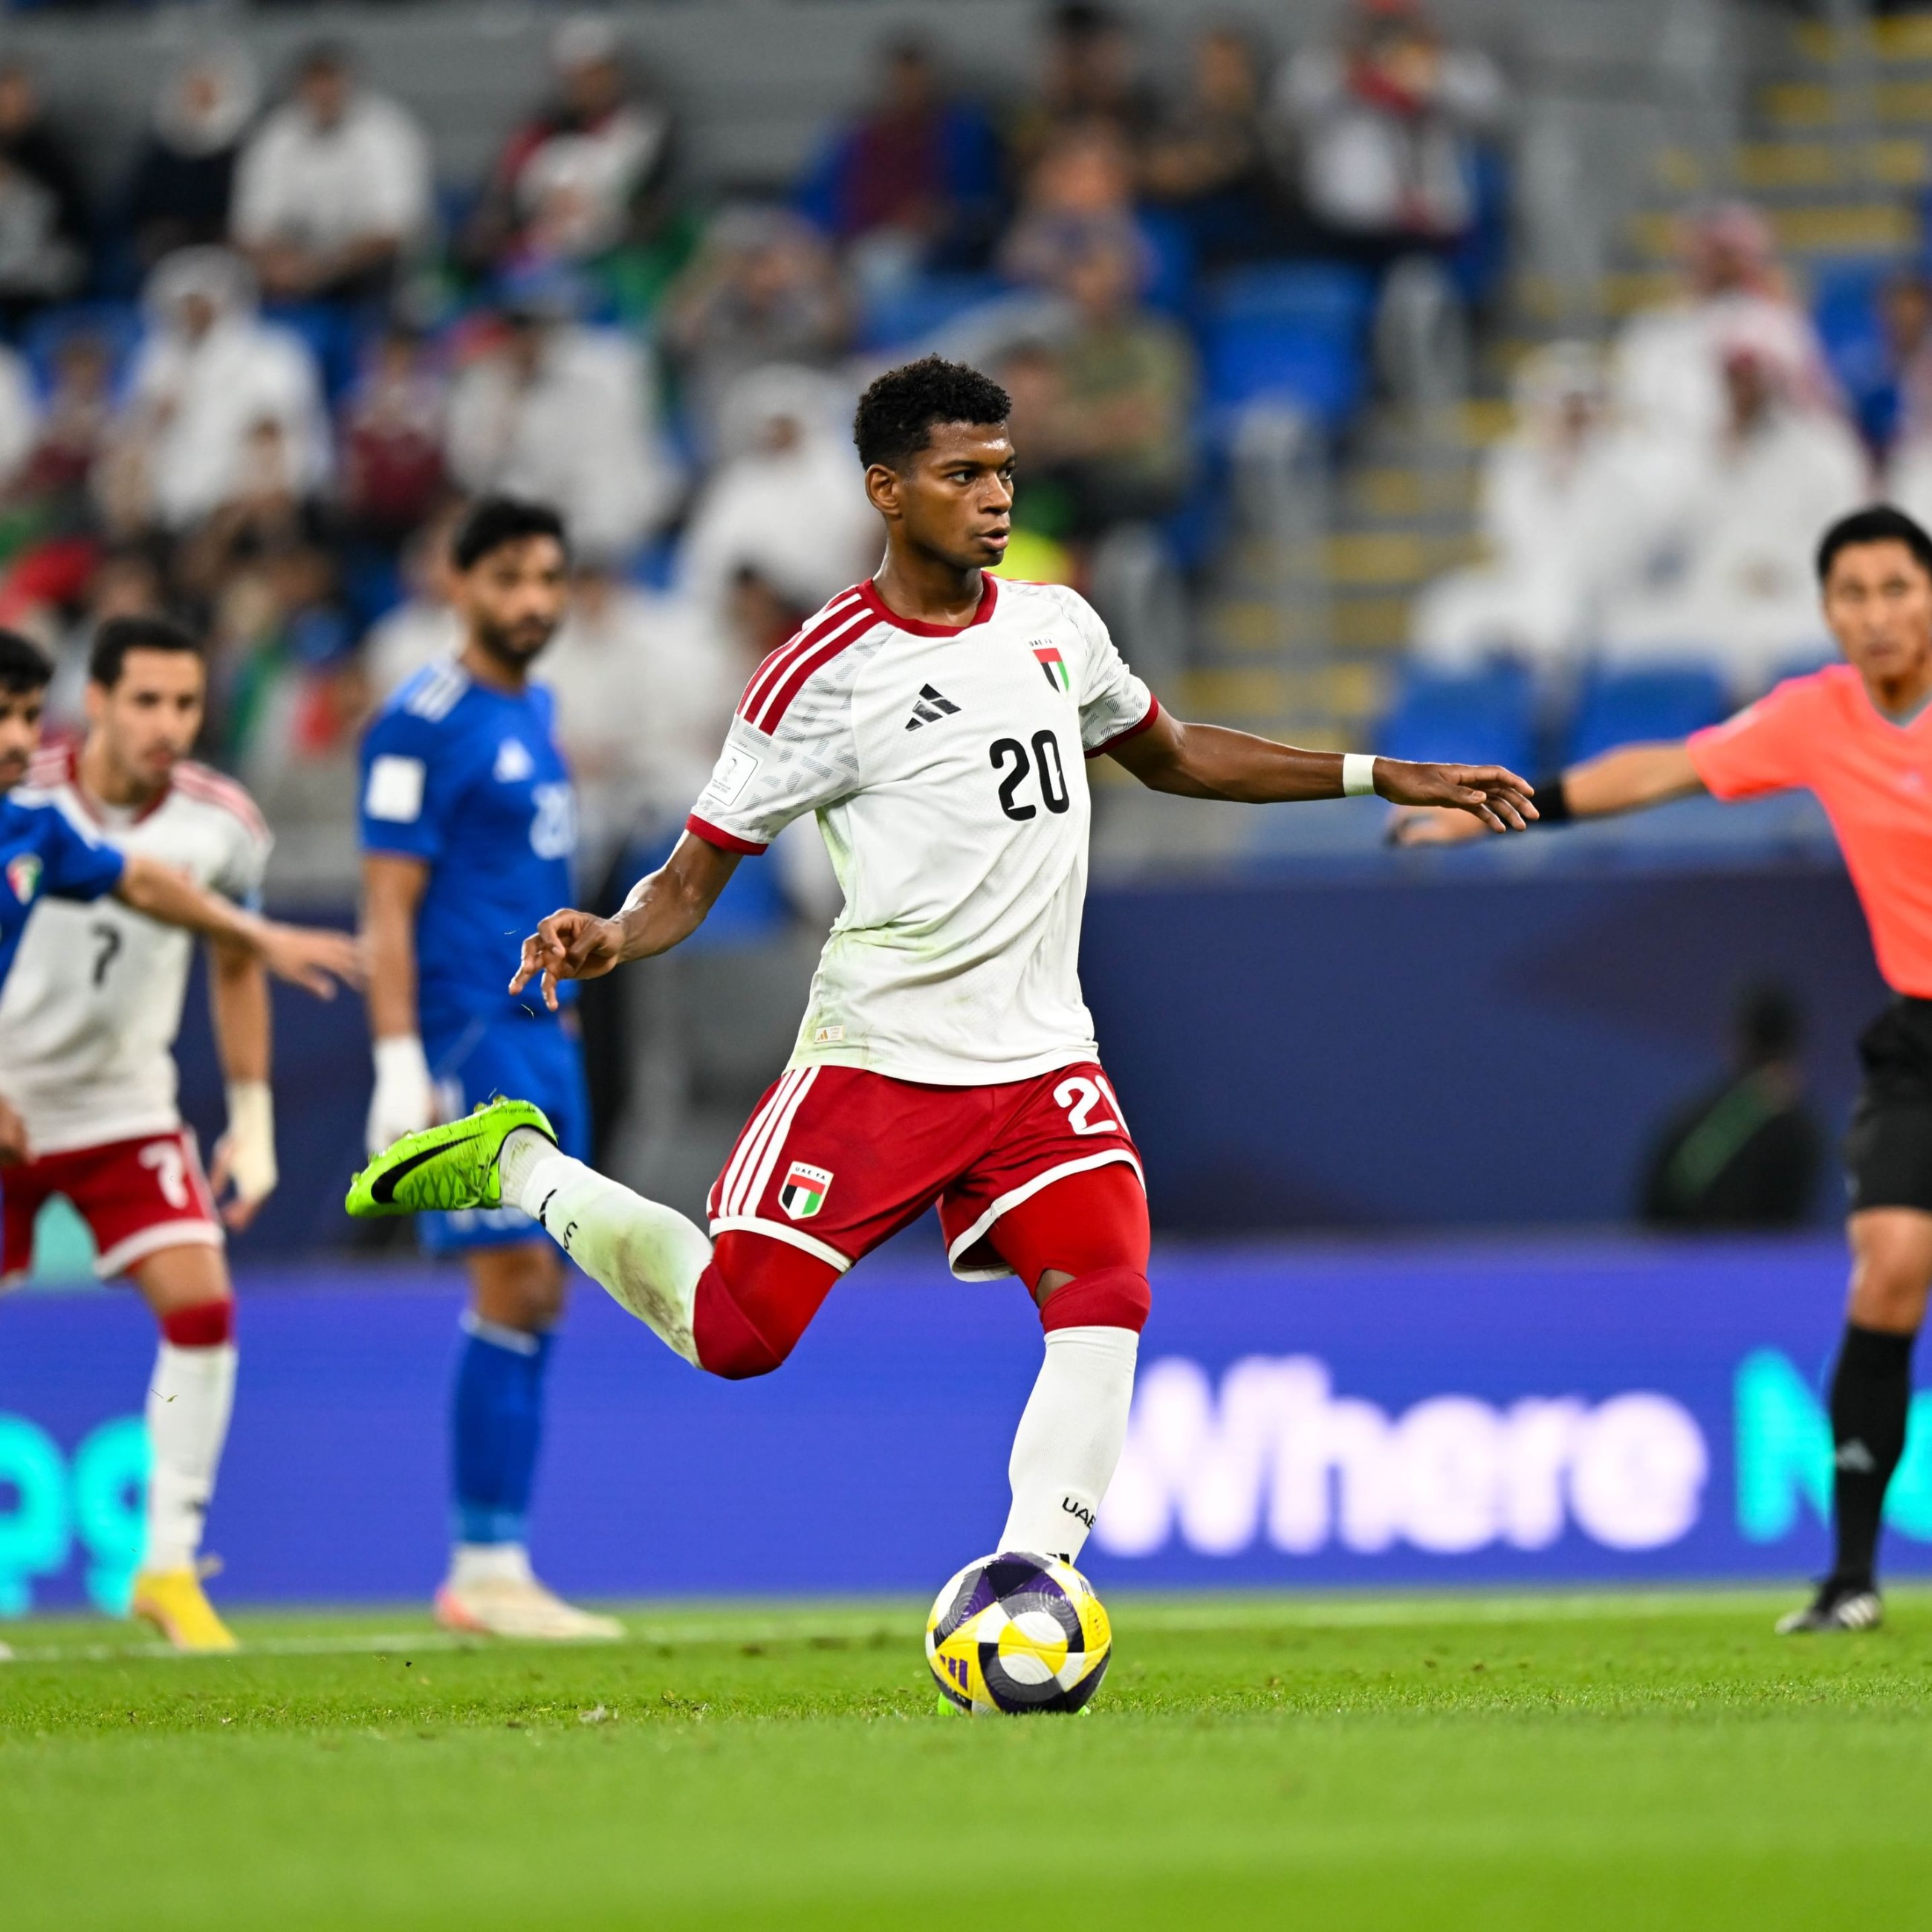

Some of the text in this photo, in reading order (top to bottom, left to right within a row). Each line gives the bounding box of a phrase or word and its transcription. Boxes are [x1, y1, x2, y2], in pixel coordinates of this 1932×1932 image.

[989, 729, 1070, 821] 20
[91, 924, 123, 990] 7
[138, 1142, 189, 1210] 7
[795, 1167, 826, 1181] UAE FA
[1095, 1355, 1708, 1555] Where
